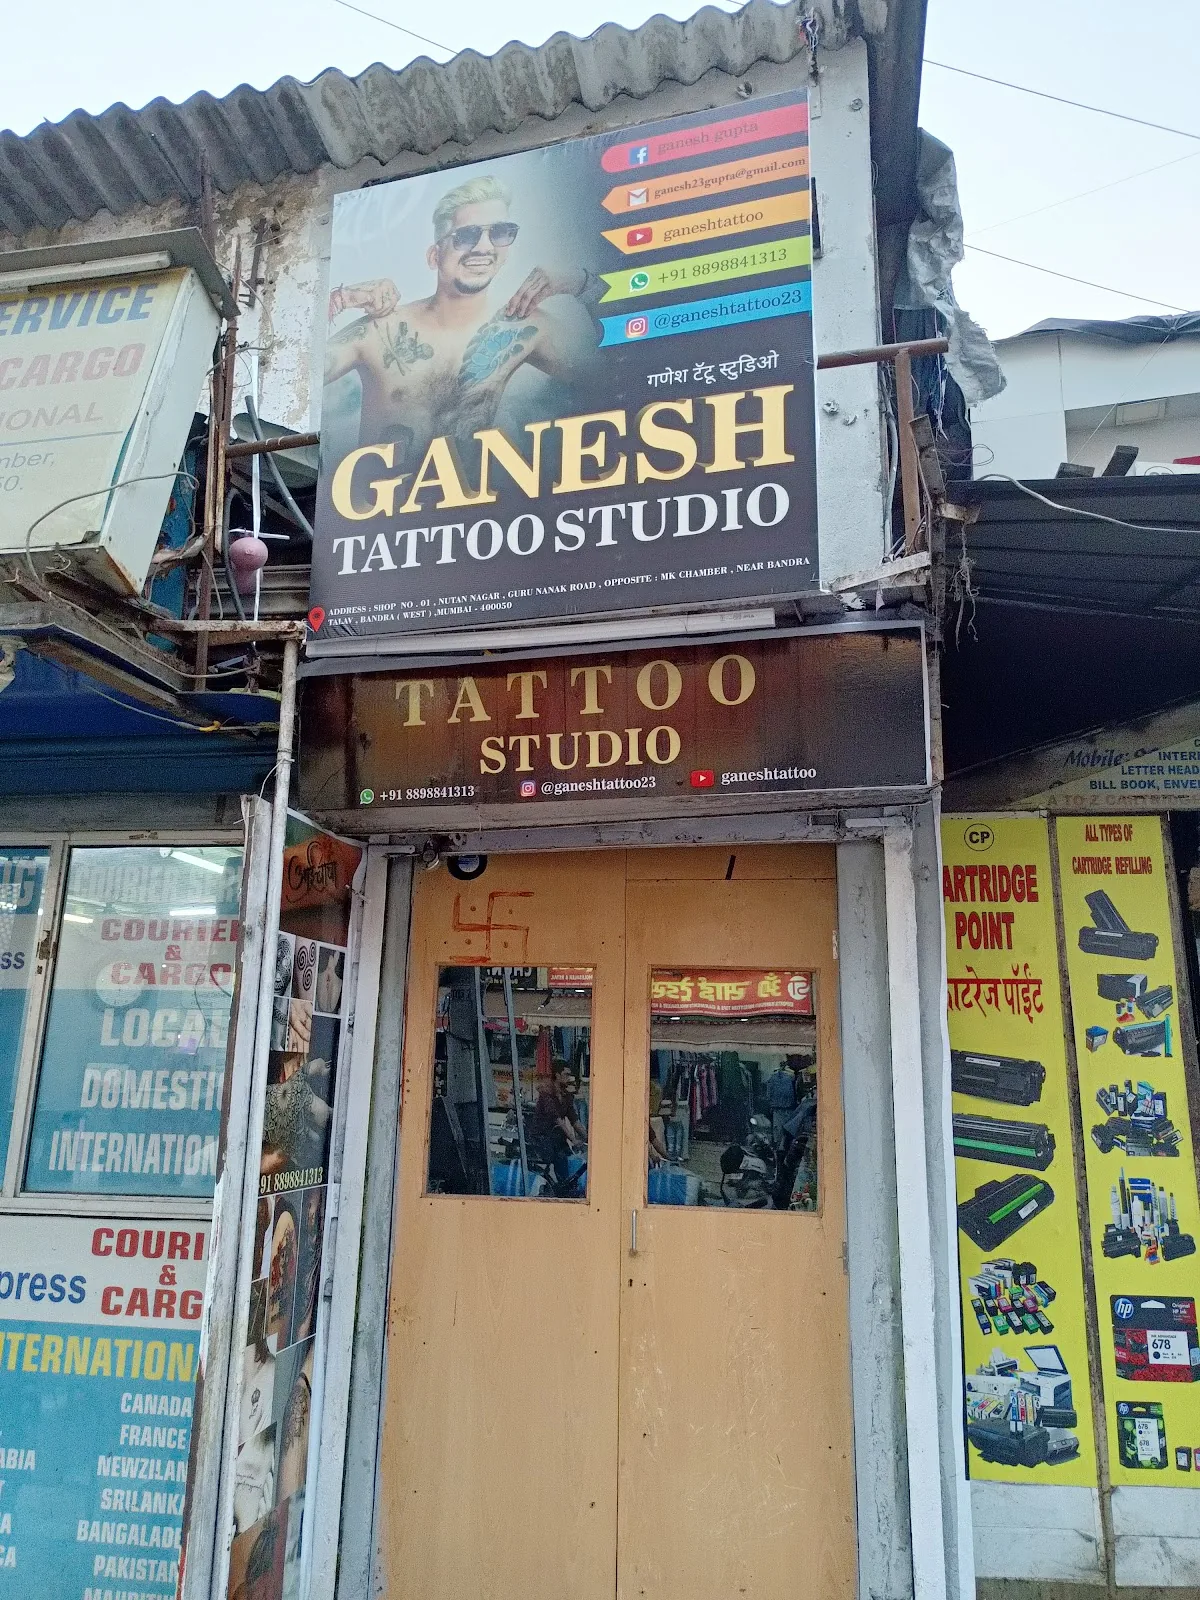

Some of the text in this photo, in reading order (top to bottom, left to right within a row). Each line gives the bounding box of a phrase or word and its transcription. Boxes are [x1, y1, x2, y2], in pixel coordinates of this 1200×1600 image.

[657, 122, 758, 155] ganesh gupta
[654, 157, 806, 199] ganesh23gupta@gmail.com
[663, 211, 763, 242] ganeshtattoo
[658, 248, 787, 283] +91 8898841313
[654, 289, 801, 329] @ganeshtattoo23
[0, 343, 146, 391] CARGO
[647, 367, 688, 387] गणेश
[719, 350, 779, 380] स्टुडिओ
[331, 384, 796, 521] GANESH
[333, 483, 790, 576] TATTOO STUDIO
[329, 557, 810, 616] ADDRESS SHOP NO 01 NUTAN NAGAR GURU NANAK ROAD OPPOSITE MK CHAMBER NEAR BANDRA
[361, 613, 395, 623] BANDRA
[403, 610, 426, 619] WEST
[481, 602, 512, 612] 400050
[395, 654, 755, 728] TATTOO
[480, 726, 682, 775] STUDIO
[720, 766, 817, 785] ganeshtattoo
[1121, 765, 1164, 775] LETTER
[380, 785, 475, 802] +91 8898841313
[541, 776, 656, 797] @ganeshtattoo23
[1090, 780, 1116, 790] BILL
[1120, 780, 1159, 791] BOOK,
[969, 831, 990, 844] CP
[1085, 824, 1133, 841] ALL TYPES OF
[1072, 857, 1152, 874] CARTRIDGE REFILLING
[955, 912, 1014, 949] POINT
[165, 945, 180, 960] &
[112, 963, 231, 985] CARGO
[273, 1166, 323, 1191] 8898841313
[91, 1227, 205, 1260] COURI
[159, 1264, 177, 1286] &
[101, 1286, 203, 1320] CARG
[1152, 1339, 1171, 1350] 678
[120, 1393, 193, 1417] CANADA
[120, 1424, 187, 1450] FRANCE
